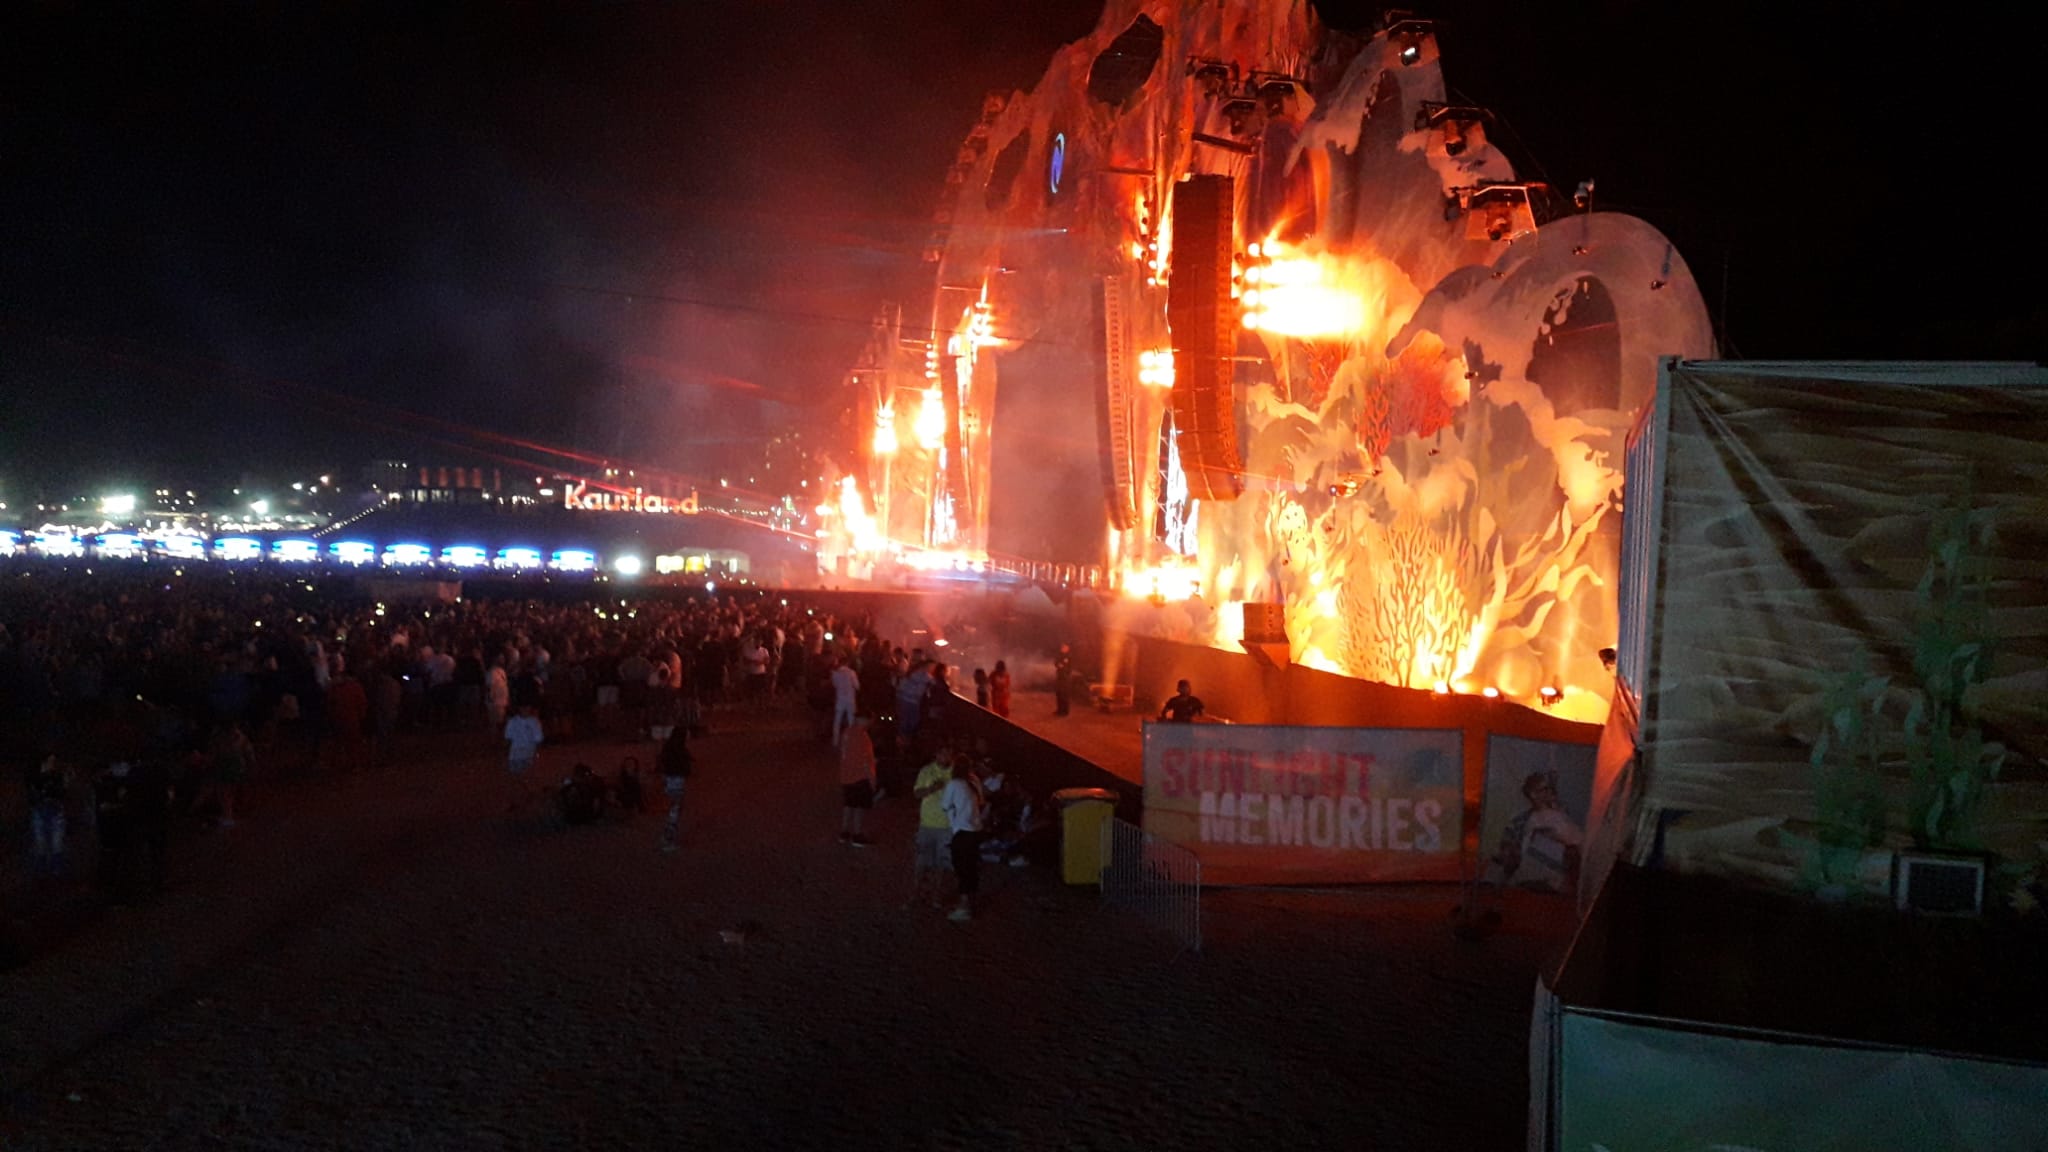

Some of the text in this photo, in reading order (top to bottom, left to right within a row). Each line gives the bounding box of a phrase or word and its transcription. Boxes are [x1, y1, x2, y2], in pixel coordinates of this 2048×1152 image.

[564, 480, 699, 514] Kaufland
[1161, 747, 1376, 801] SUNLIGHT
[1199, 791, 1443, 853] MEMORIES
